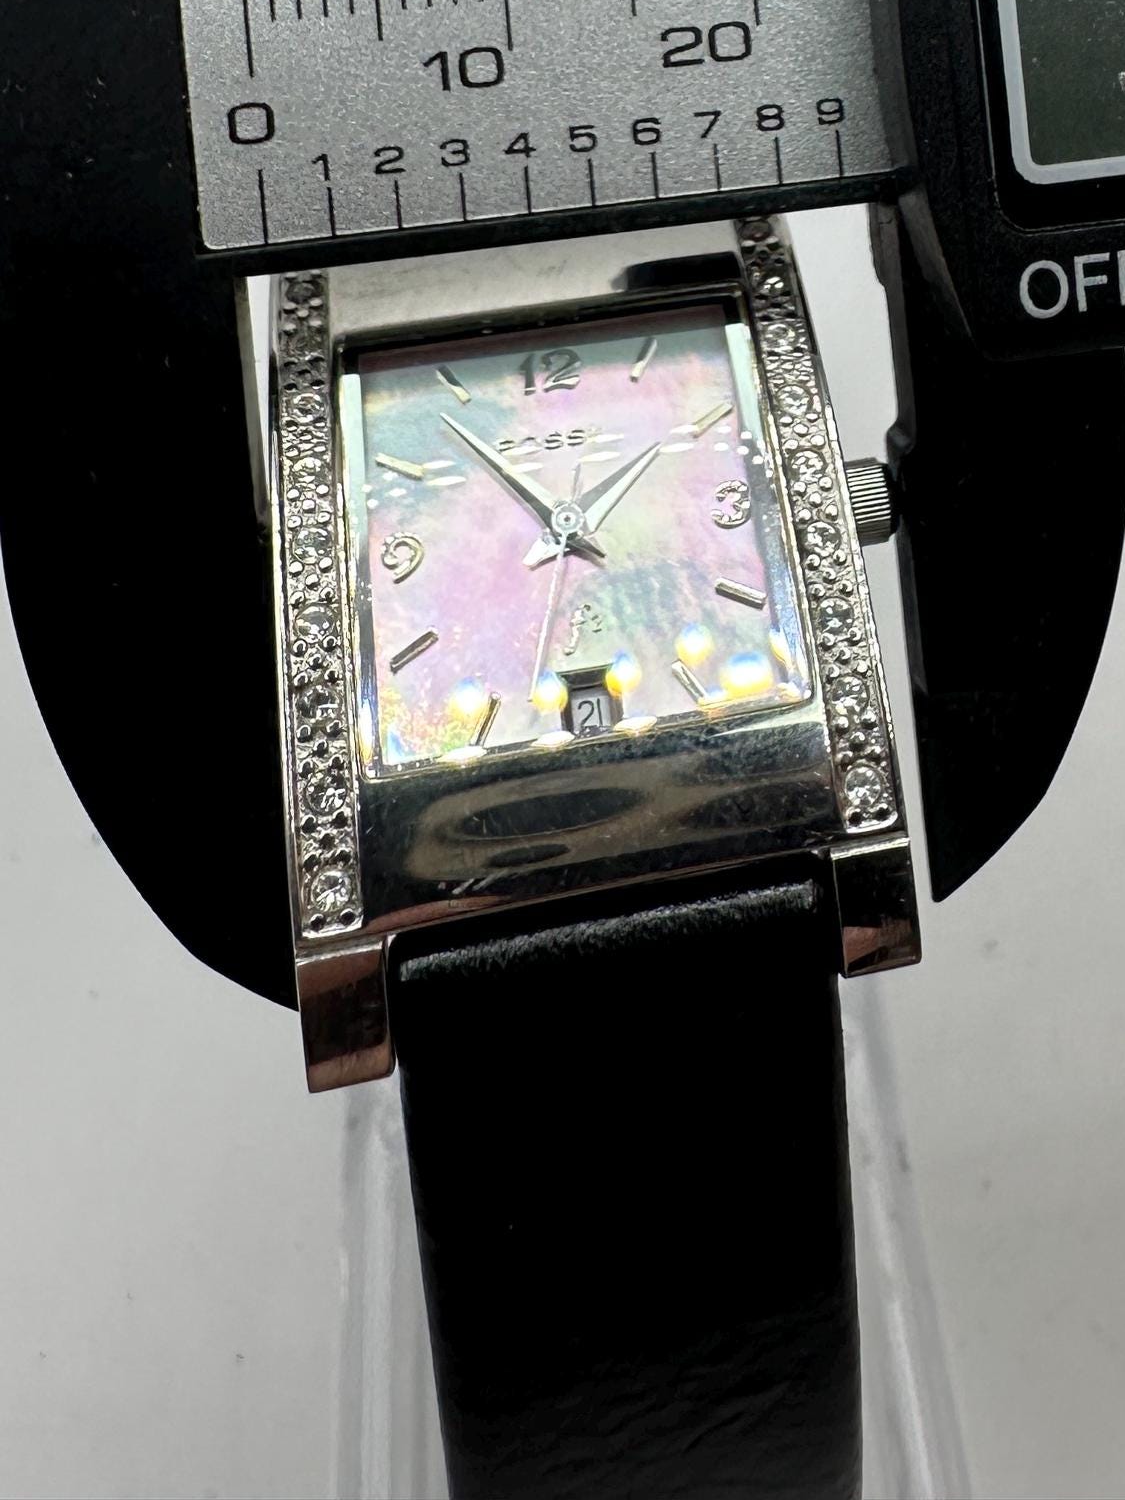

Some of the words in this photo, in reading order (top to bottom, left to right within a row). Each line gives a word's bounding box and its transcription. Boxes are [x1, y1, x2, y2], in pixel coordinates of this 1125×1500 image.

[227, 102, 275, 145] 0
[422, 47, 504, 91] 10
[660, 21, 752, 68] 20
[311, 153, 331, 181] 1
[373, 147, 406, 175] 2
[441, 139, 470, 167] 3
[505, 132, 535, 157] 4
[569, 125, 597, 153] 5
[632, 118, 661, 146] 6
[694, 111, 721, 139] 7
[756, 104, 785, 132] 8
[817, 98, 845, 125] 9
[519, 348, 581, 396] 12
[710, 479, 751, 529] 3
[381, 532, 424, 583] 9
[577, 697, 604, 728] 21
